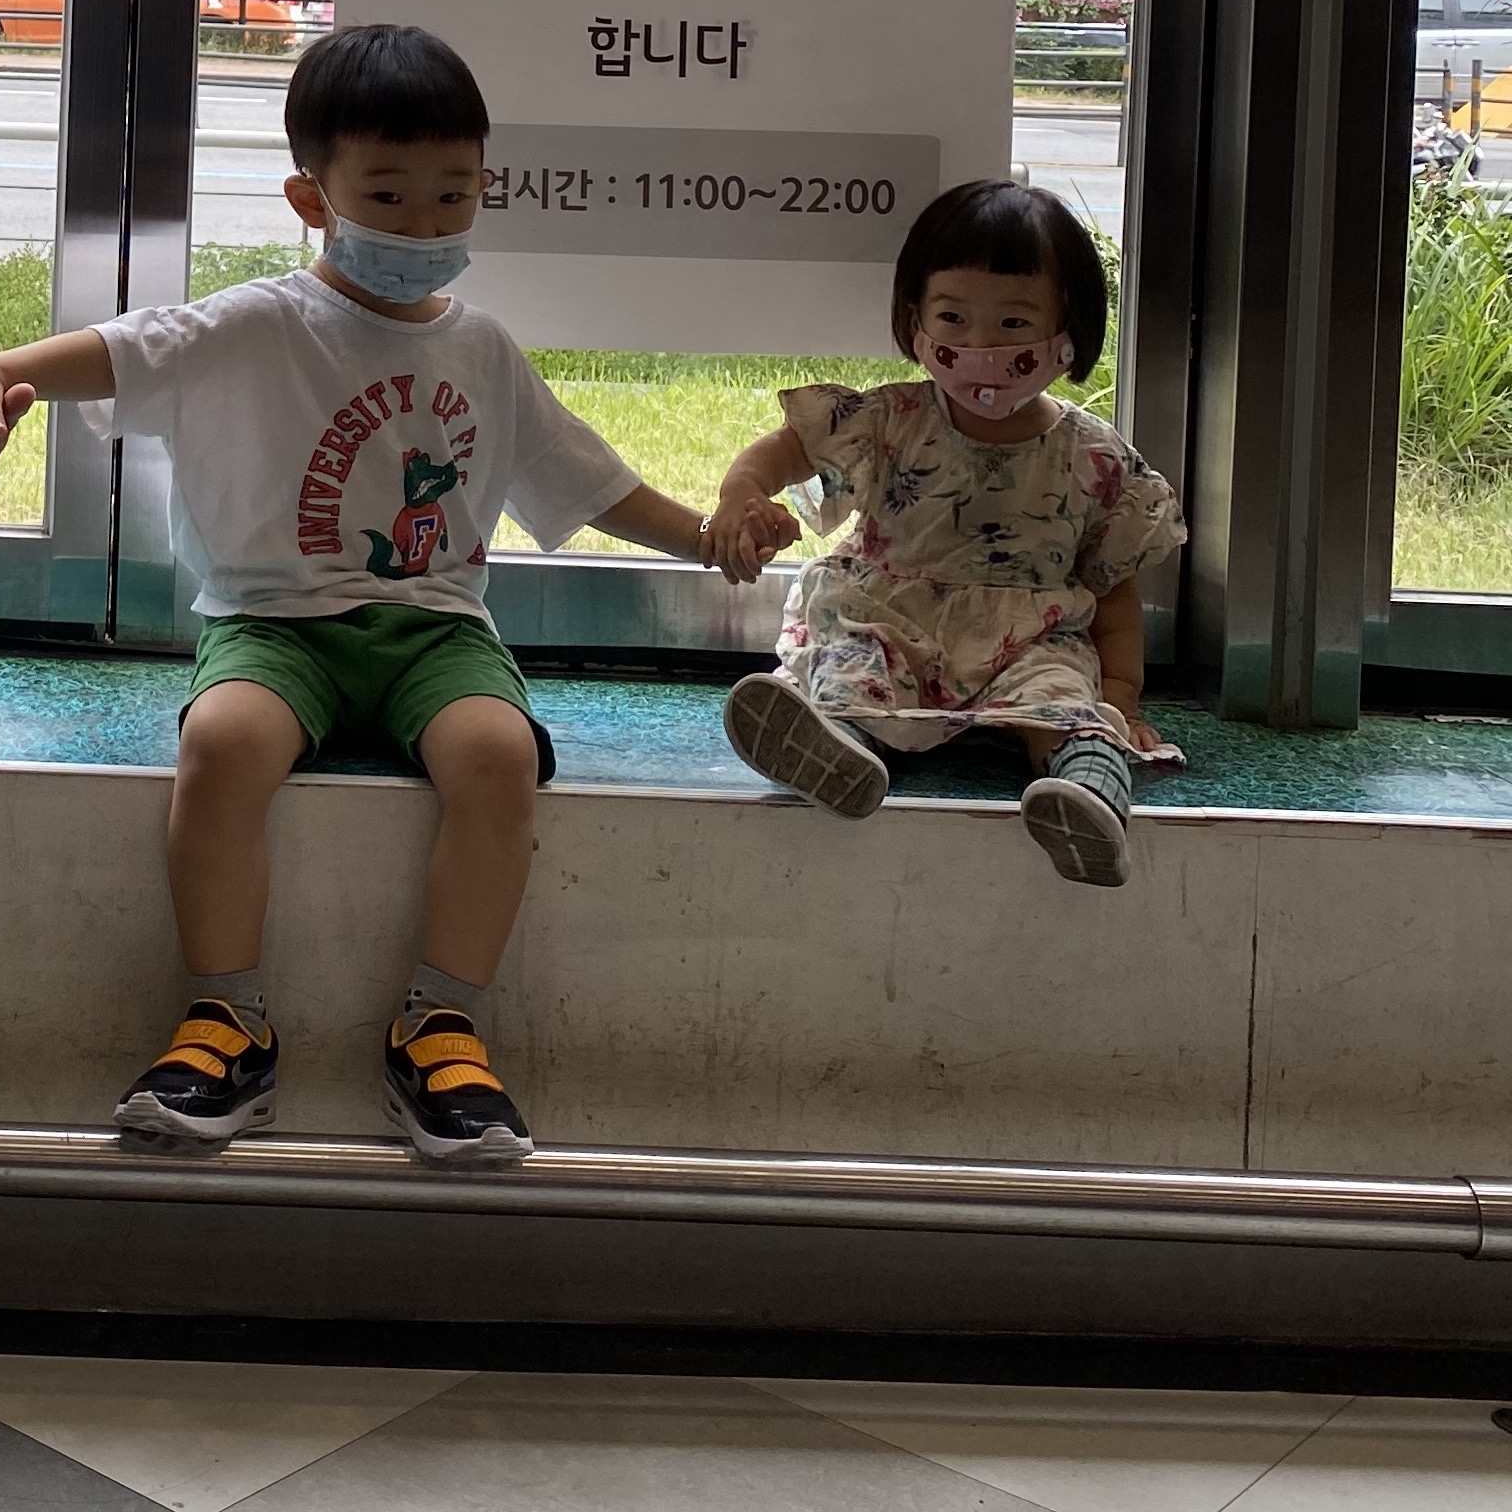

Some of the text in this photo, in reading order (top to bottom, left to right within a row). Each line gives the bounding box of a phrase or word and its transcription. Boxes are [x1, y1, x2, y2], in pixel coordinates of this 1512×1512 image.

[587, 15, 748, 80] 합니다
[480, 166, 594, 212] 업시간
[634, 172, 897, 216] 11:00~22:00
[297, 373, 416, 556] UNIVERSITY
[431, 379, 471, 426] OF
[410, 513, 439, 562] F
